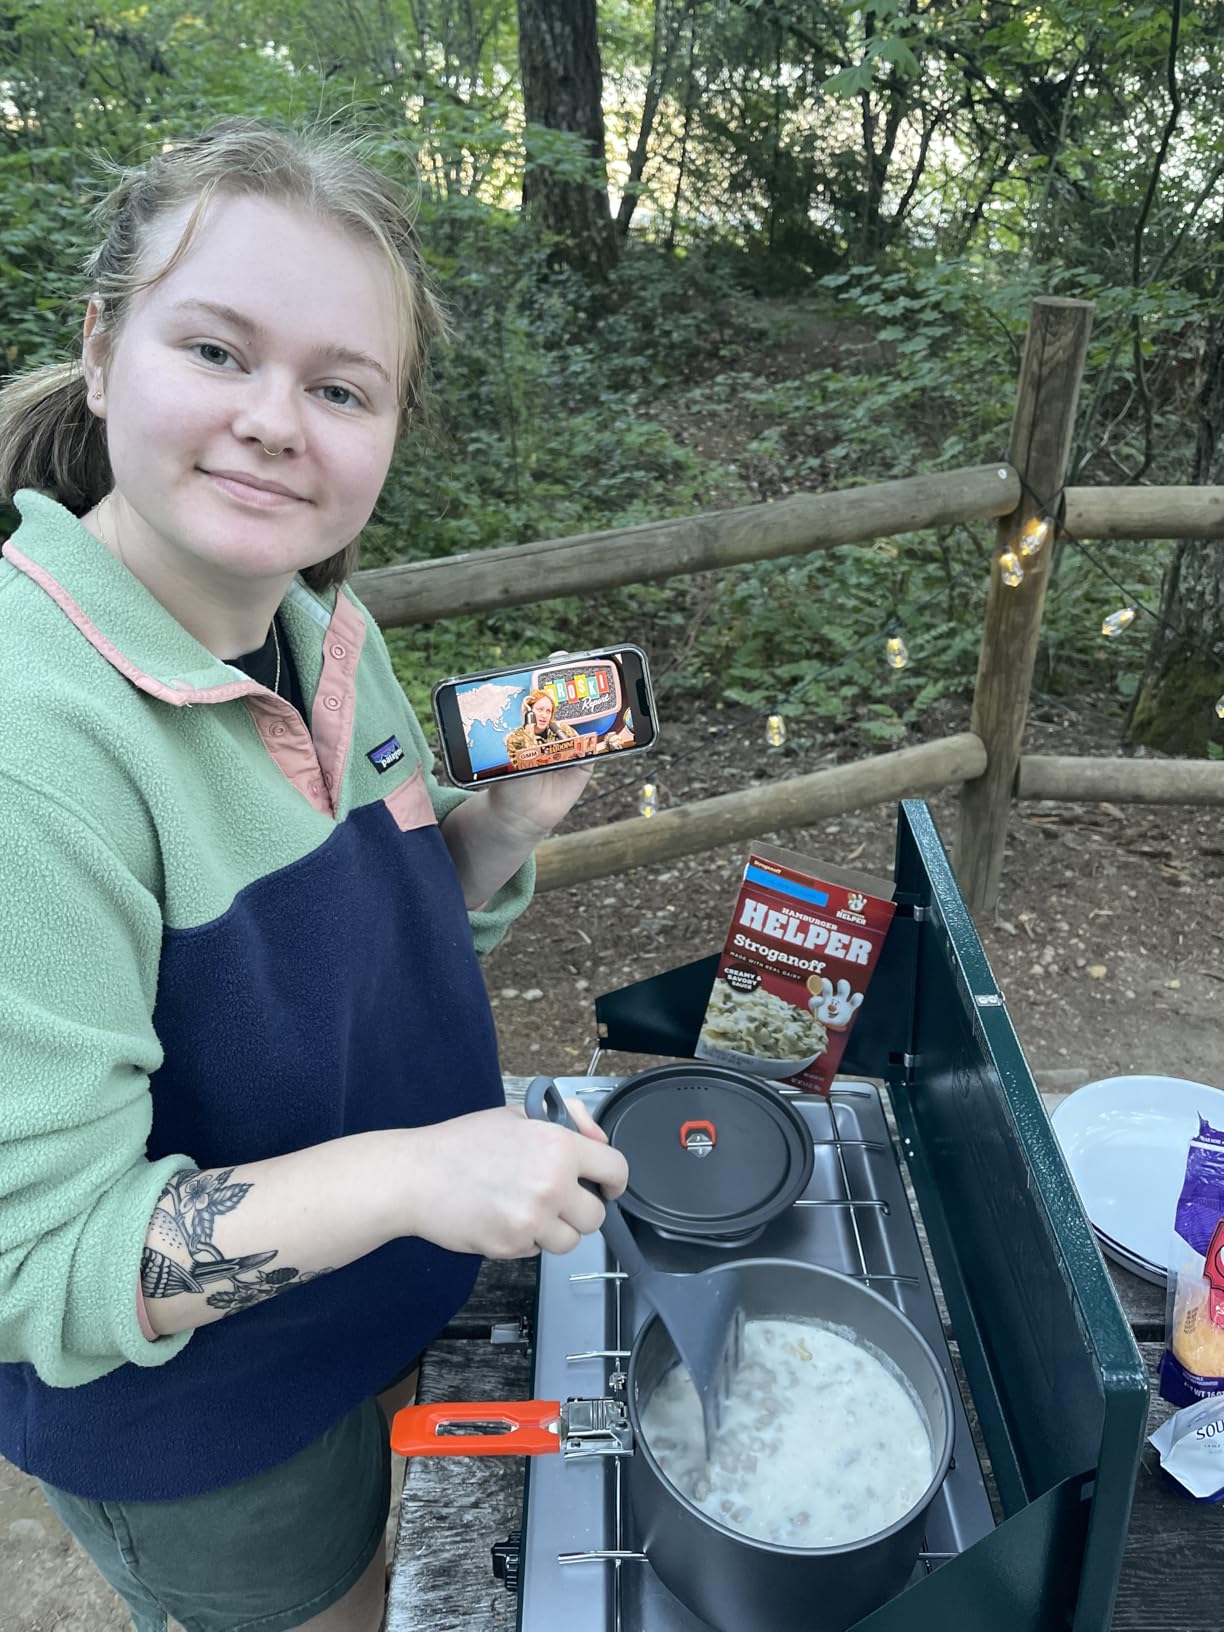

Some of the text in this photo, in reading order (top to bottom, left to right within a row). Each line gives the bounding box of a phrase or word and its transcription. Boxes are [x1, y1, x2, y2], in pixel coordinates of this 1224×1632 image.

[581, 694, 610, 712] Report
[781, 907, 838, 930] HAMBURGER
[835, 910, 867, 925] HELPER
[739, 898, 873, 965] HELPER
[733, 933, 827, 974] Stroganoff
[724, 967, 757, 979] CREAMY
[729, 951, 802, 980] MADE WITH REAL DAIRY
[727, 974, 758, 986] SAVORY
[731, 981, 752, 990] SAUCE
